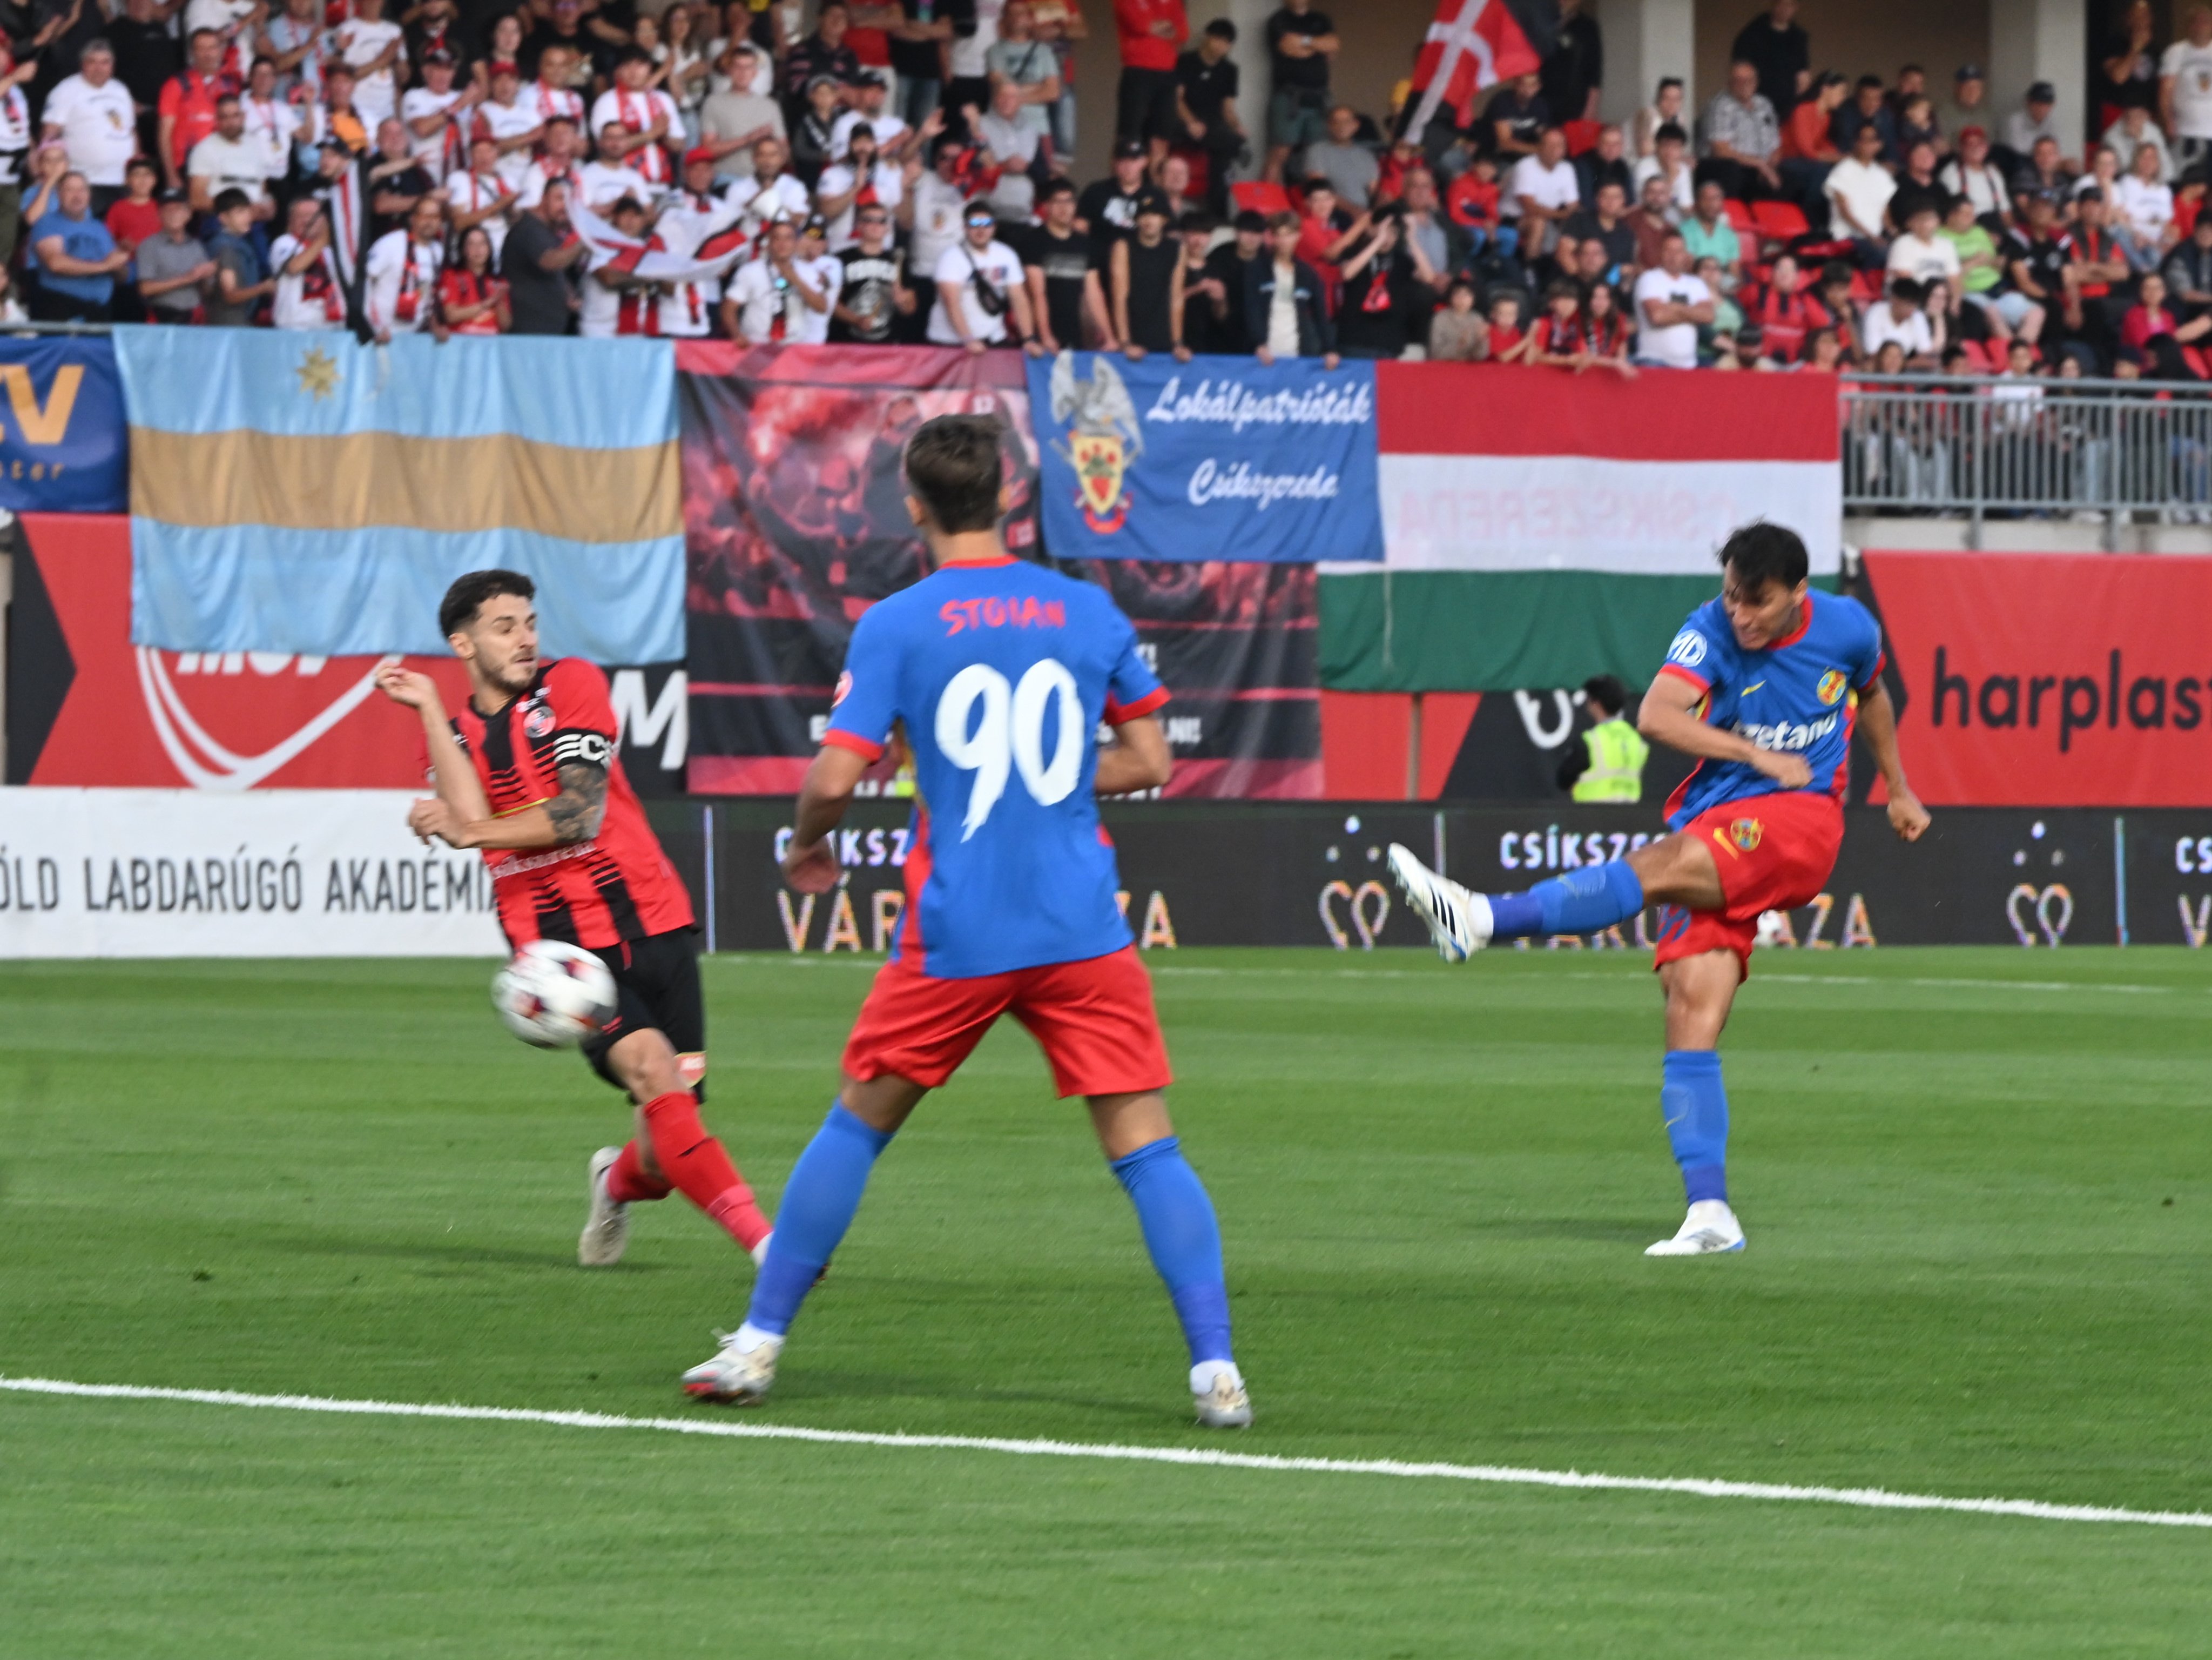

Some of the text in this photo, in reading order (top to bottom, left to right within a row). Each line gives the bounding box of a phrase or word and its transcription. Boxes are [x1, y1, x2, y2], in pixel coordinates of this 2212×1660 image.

[939, 596, 1066, 638] STOIAN
[1933, 646, 2212, 752] harplas
[935, 657, 1085, 844] 90
[84, 843, 302, 912] LABDARÚGÓ
[1500, 823, 1668, 869] CSÍKSZ
